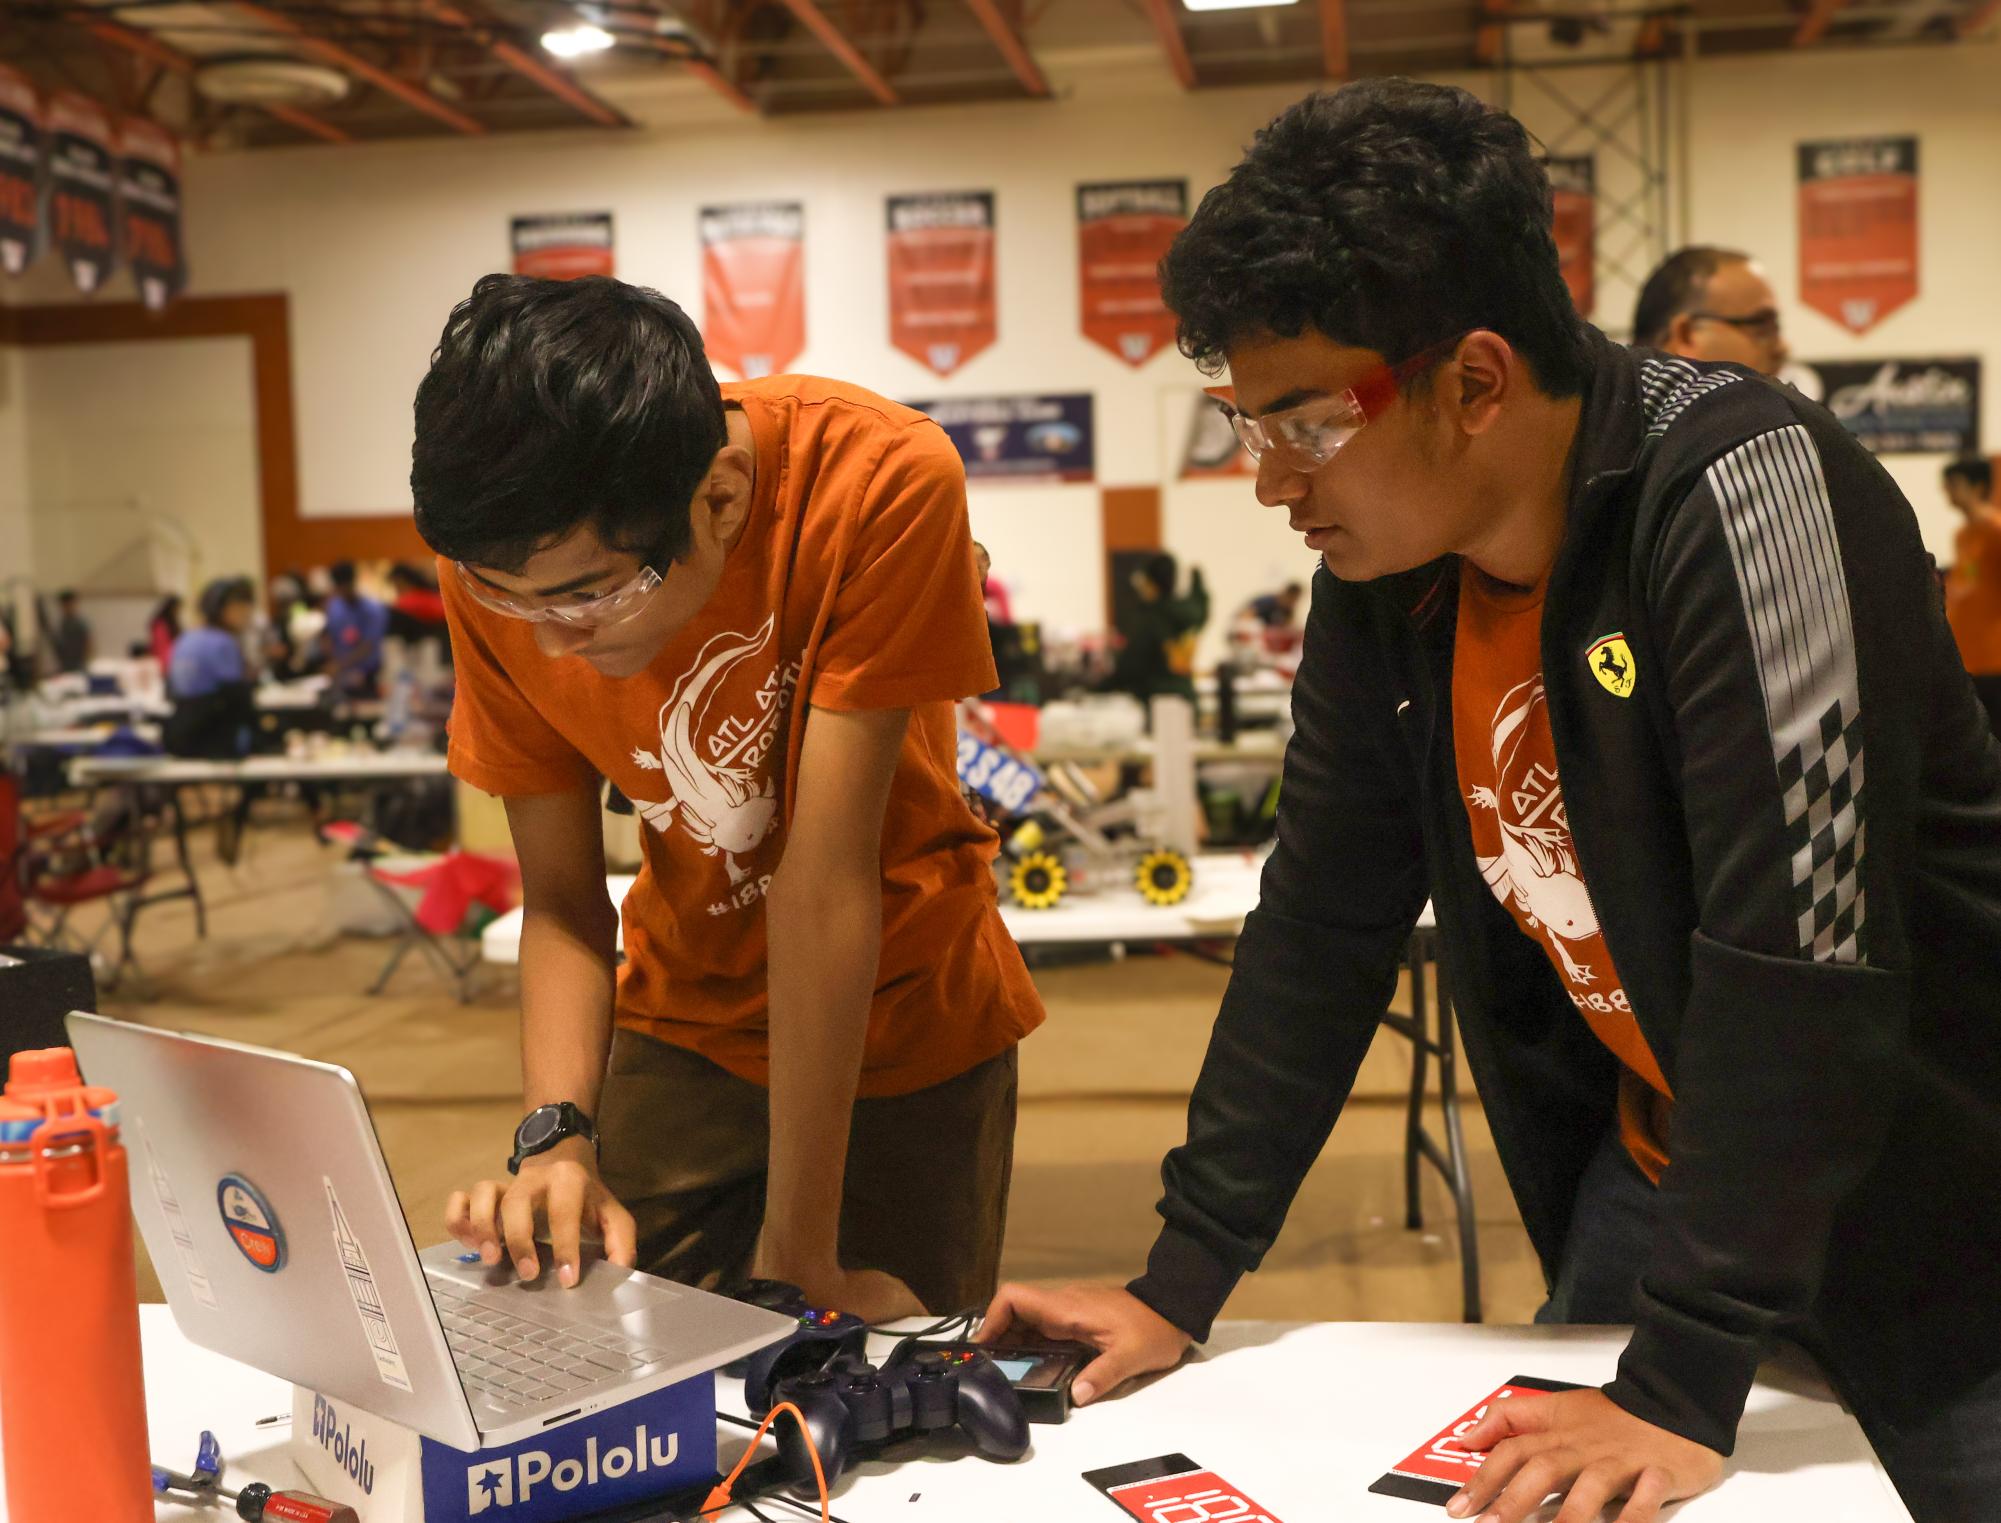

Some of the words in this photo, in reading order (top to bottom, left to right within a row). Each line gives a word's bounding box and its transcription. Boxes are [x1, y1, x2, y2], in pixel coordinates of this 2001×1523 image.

[708, 715, 755, 757] ATL
[755, 664, 781, 711] AT
[325, 1404, 374, 1495] Pololu
[518, 1424, 679, 1503] Pololu
